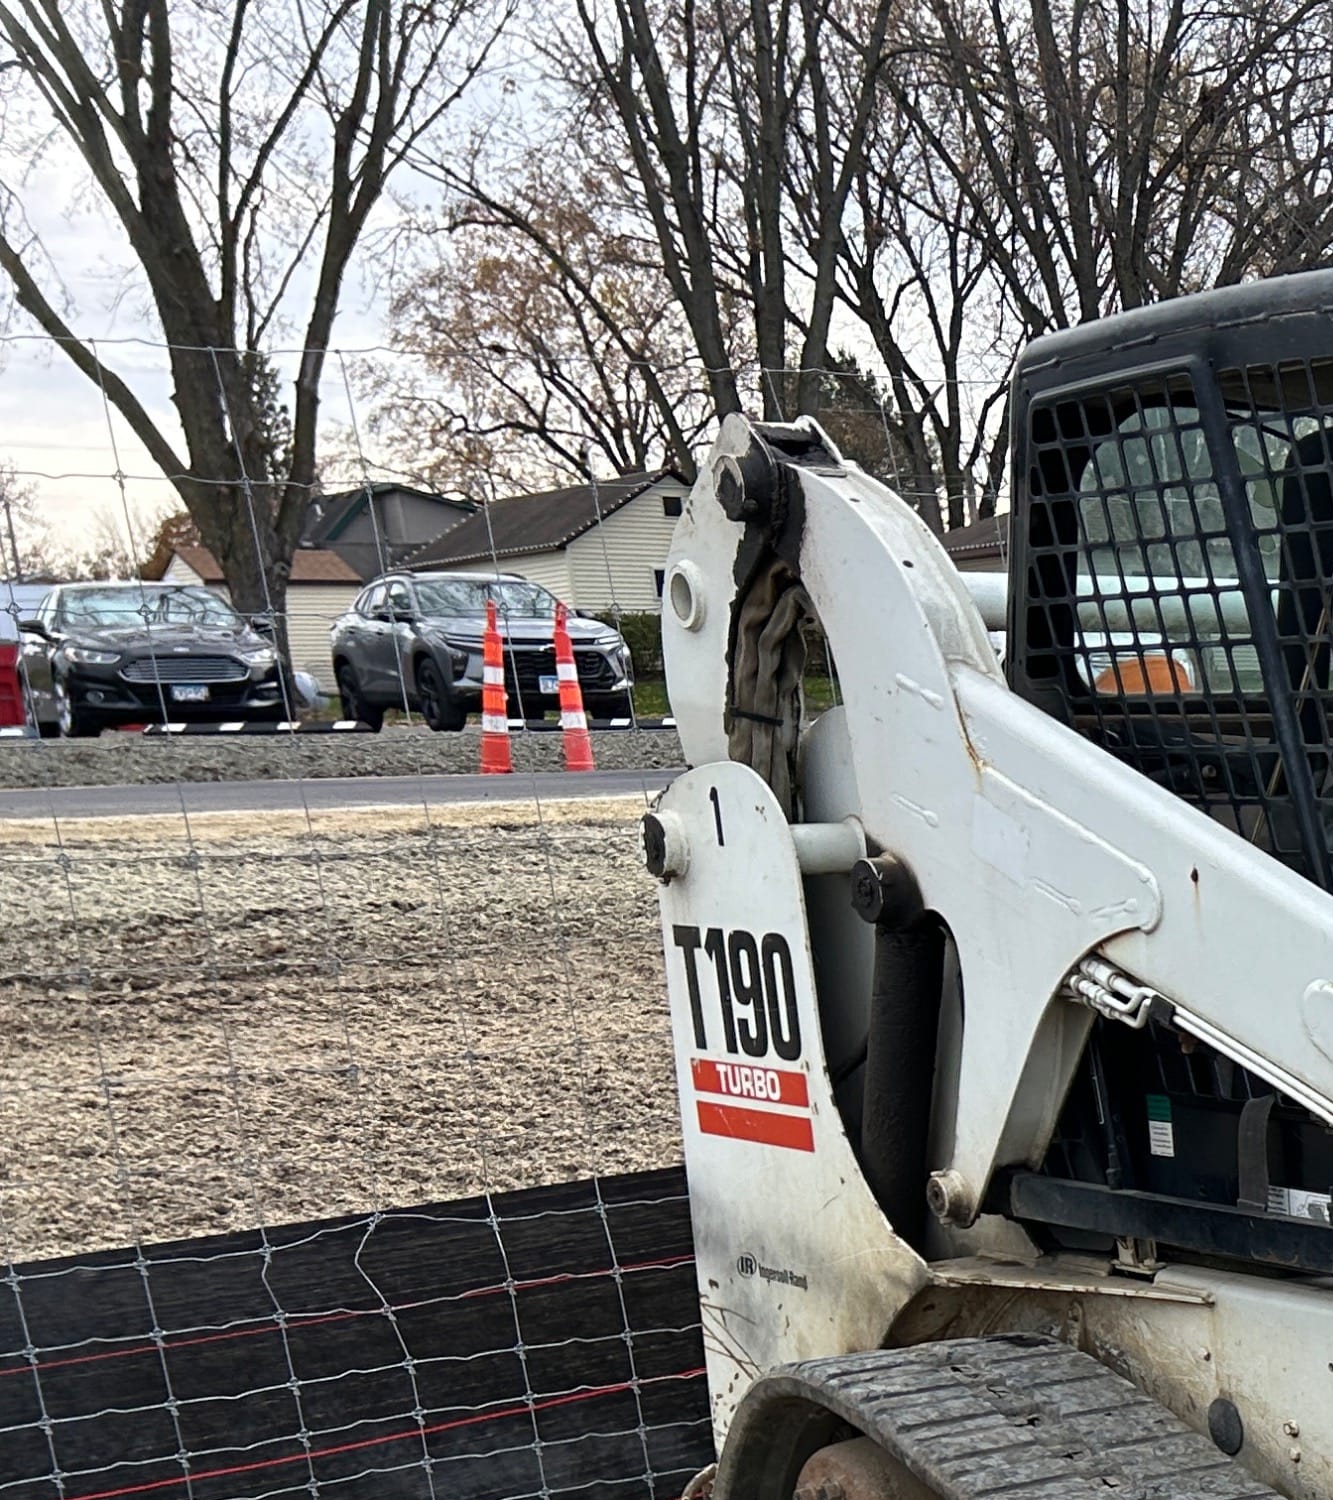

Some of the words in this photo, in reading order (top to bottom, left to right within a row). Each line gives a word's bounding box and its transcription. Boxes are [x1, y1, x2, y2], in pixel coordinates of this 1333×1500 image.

[709, 786, 724, 846] 1
[672, 924, 801, 1061] T190
[715, 1064, 781, 1101] TURBO
